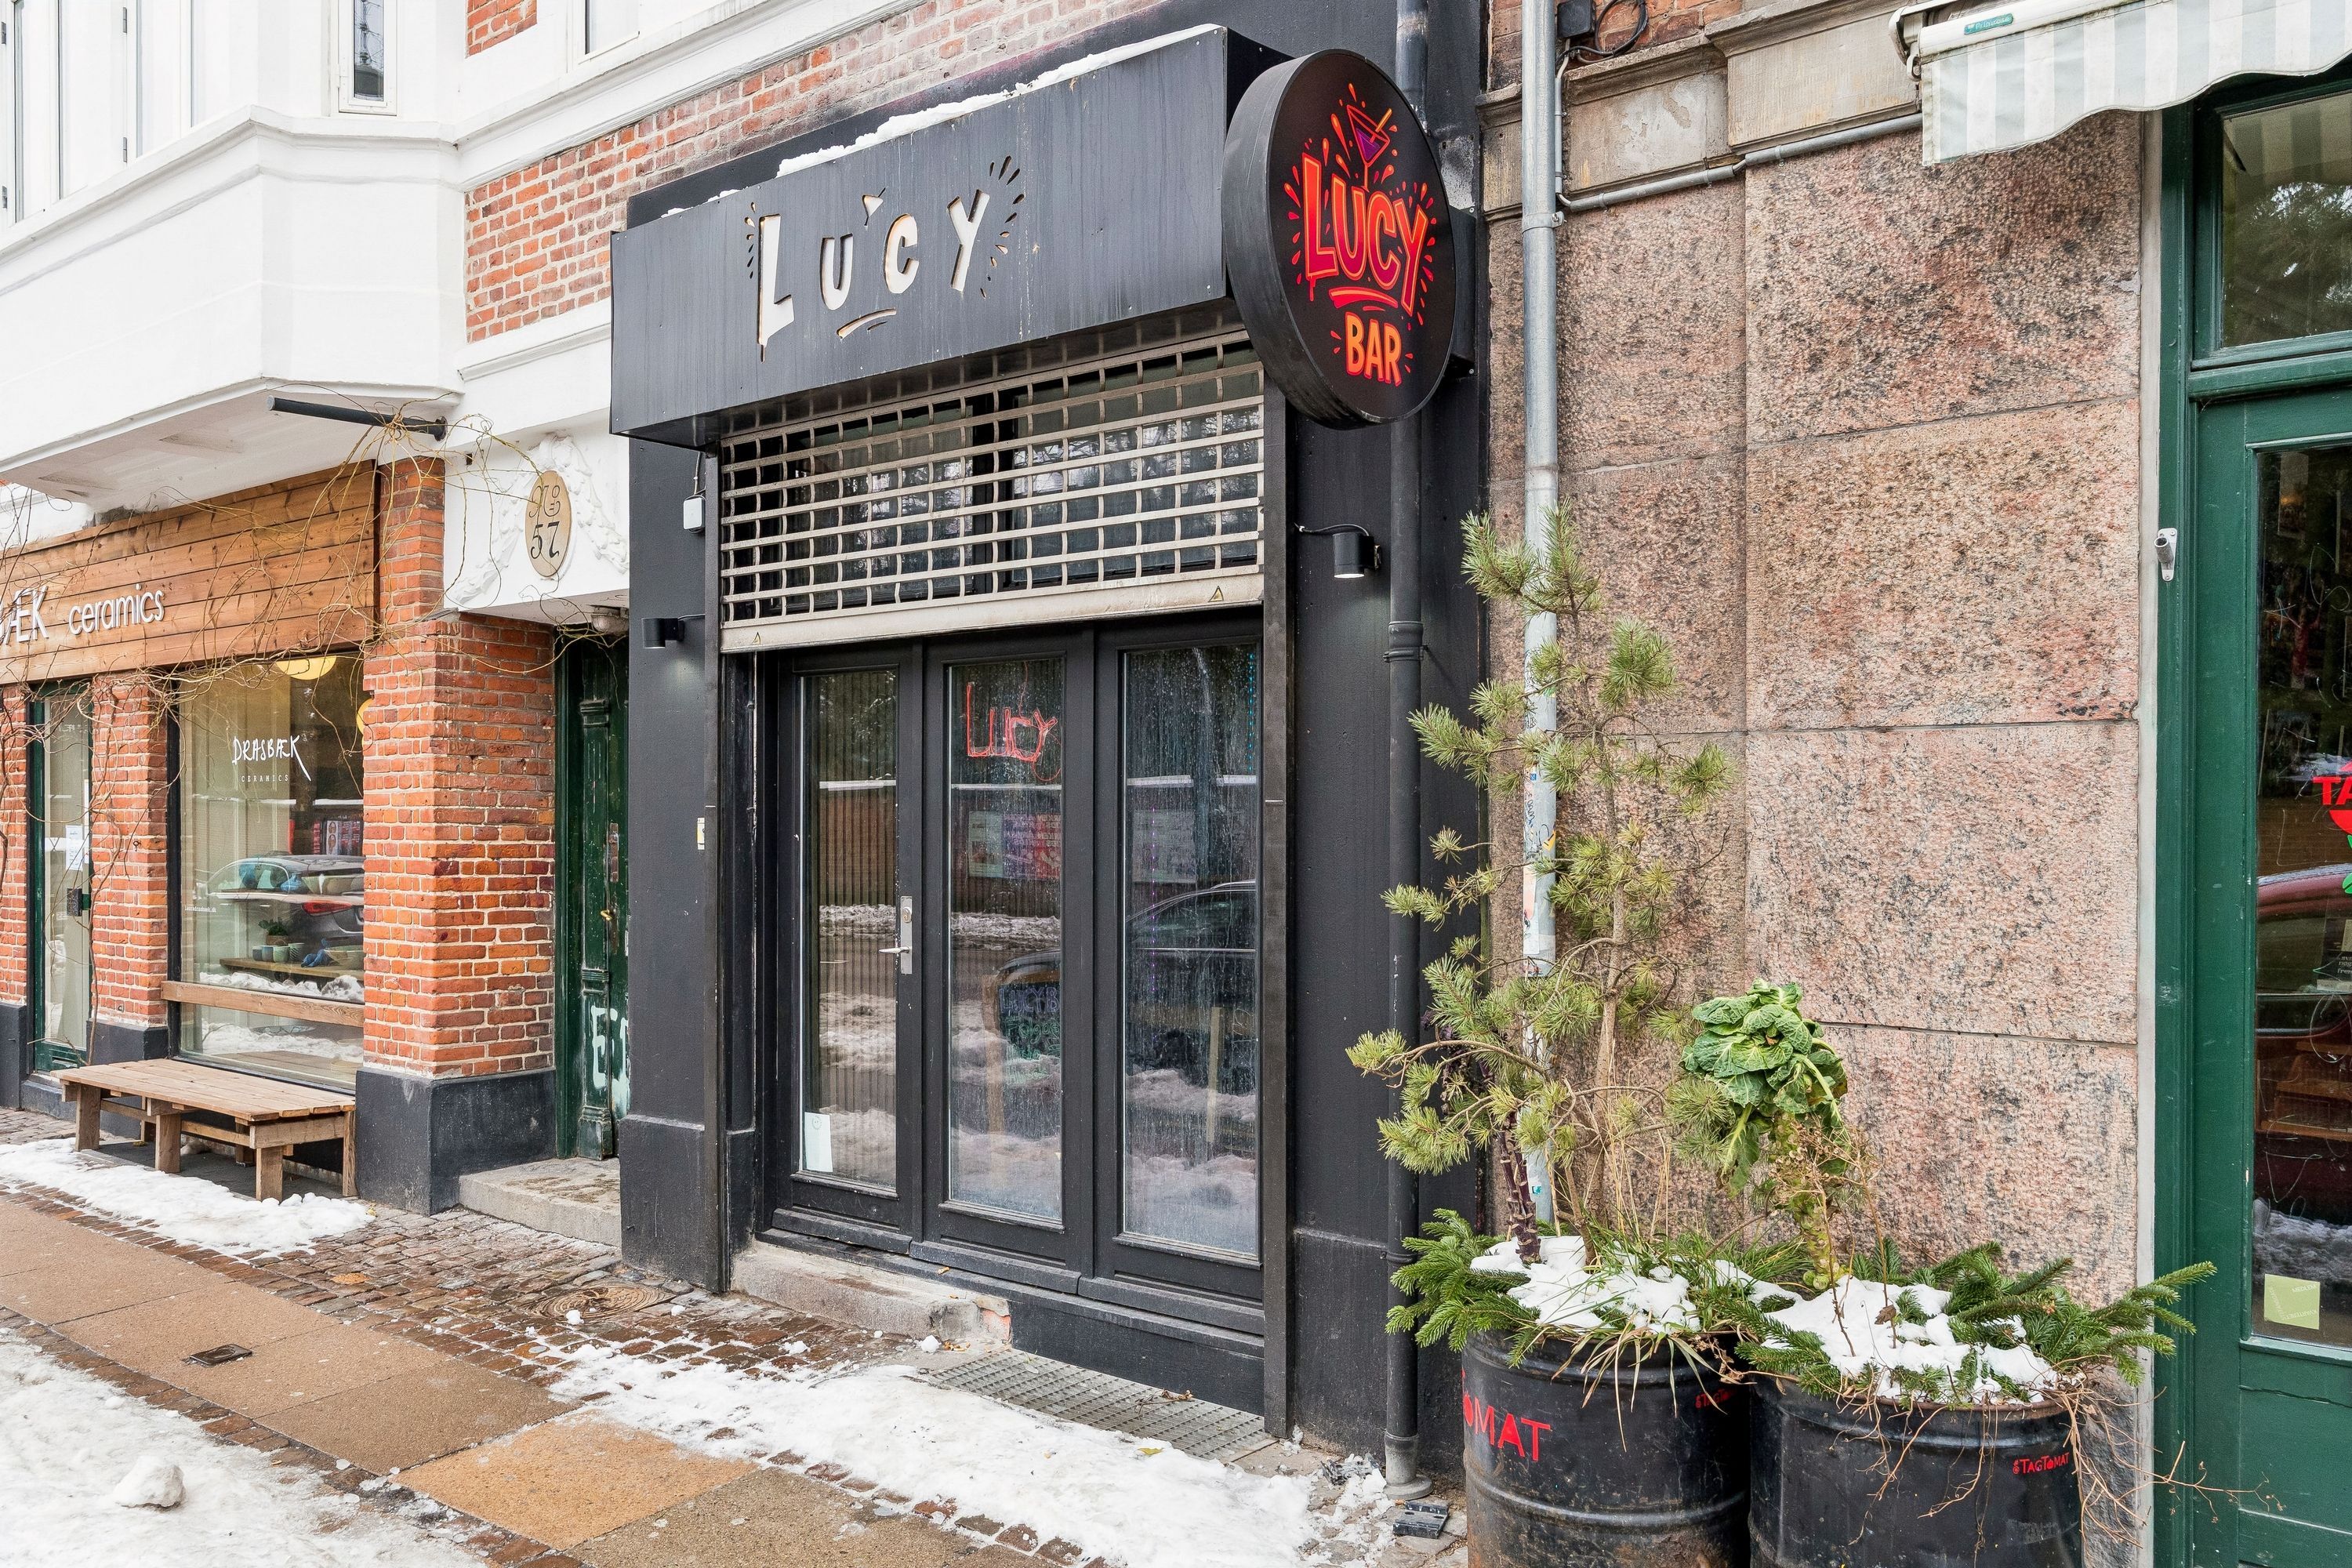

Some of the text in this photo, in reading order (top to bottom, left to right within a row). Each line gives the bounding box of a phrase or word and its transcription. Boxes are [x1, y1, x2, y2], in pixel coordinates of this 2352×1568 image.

[1302, 152, 1428, 317] LUCY
[757, 189, 990, 350] LUCY
[1345, 311, 1402, 387] BAR
[531, 521, 560, 559] 57
[68, 583, 165, 635] ceramics
[232, 735, 311, 782] DRASBÆK
[241, 774, 289, 782] CERAMICS
[1461, 1393, 1550, 1461] OMAT
